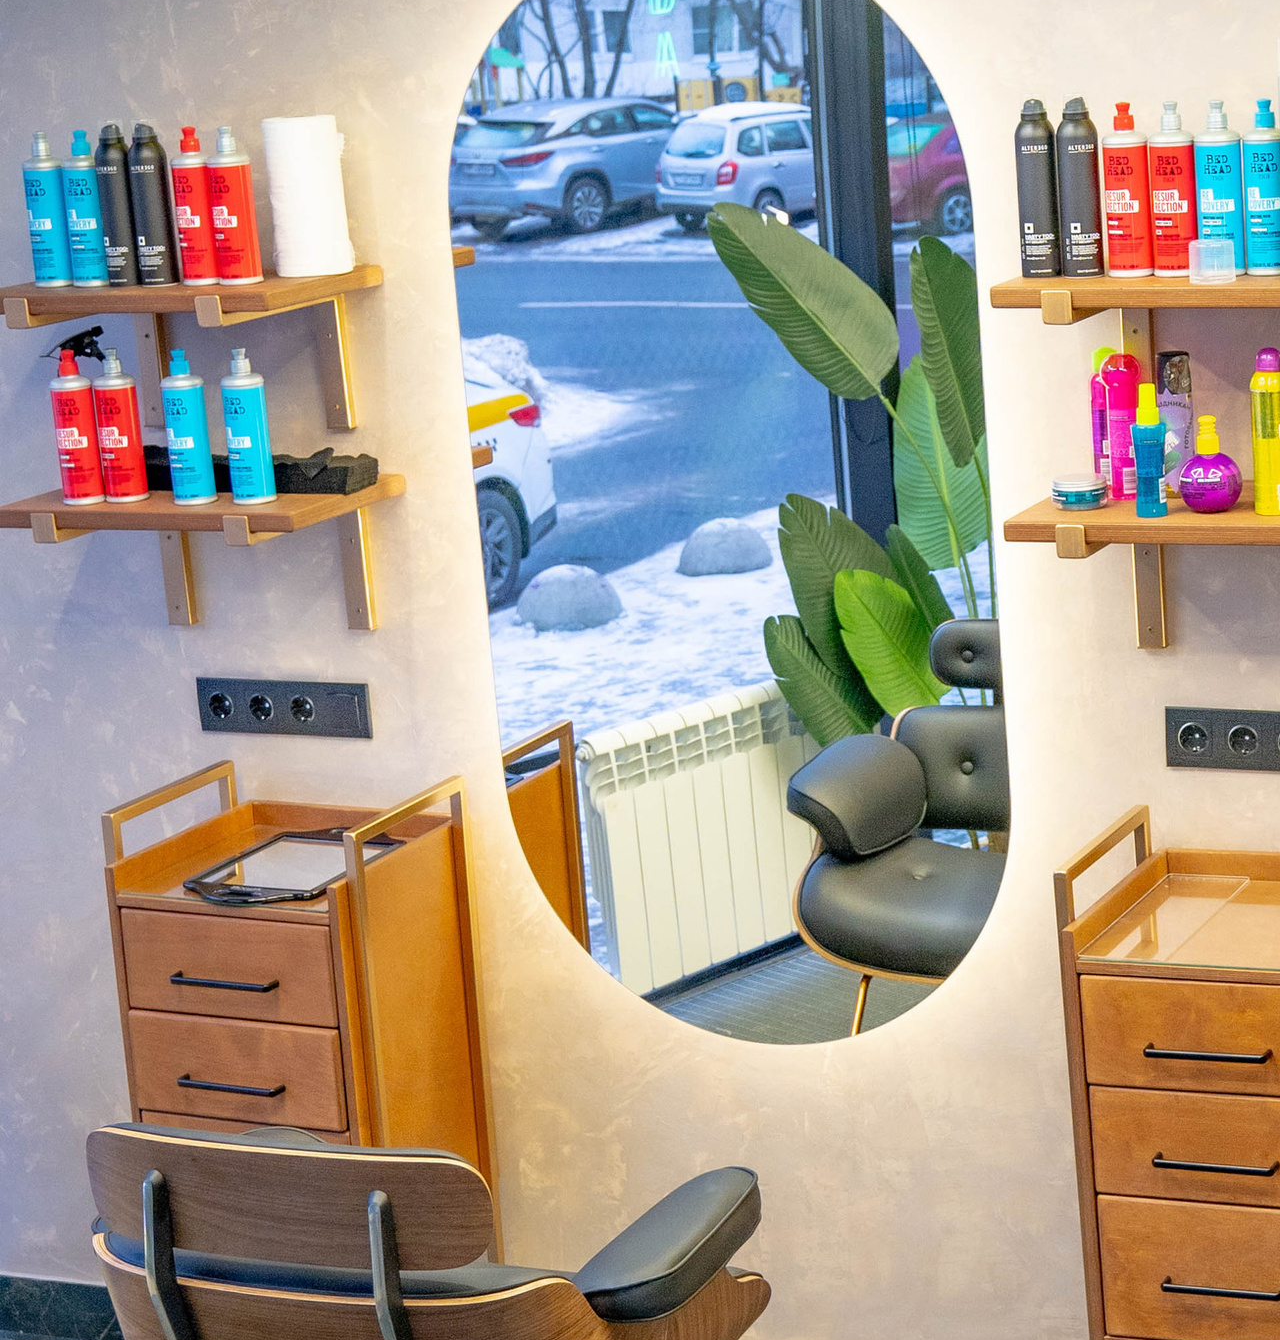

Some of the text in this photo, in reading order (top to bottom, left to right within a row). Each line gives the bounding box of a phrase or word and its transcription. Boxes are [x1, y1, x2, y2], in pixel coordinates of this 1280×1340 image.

[1109, 156, 1129, 165] BED
[1157, 156, 1178, 165] BED
[1206, 154, 1228, 164] BED
[1252, 152, 1274, 162] BED
[1107, 166, 1133, 175] HEAD
[1155, 166, 1182, 175] HEAD
[1204, 164, 1231, 174] HEAD
[1250, 163, 1278, 172] HEAD
[68, 178, 88, 187] BED
[1154, 191, 1175, 201] RESUR
[1155, 202, 1183, 212] RECTION
[165, 398, 183, 406] BED
[224, 397, 242, 406] BED
